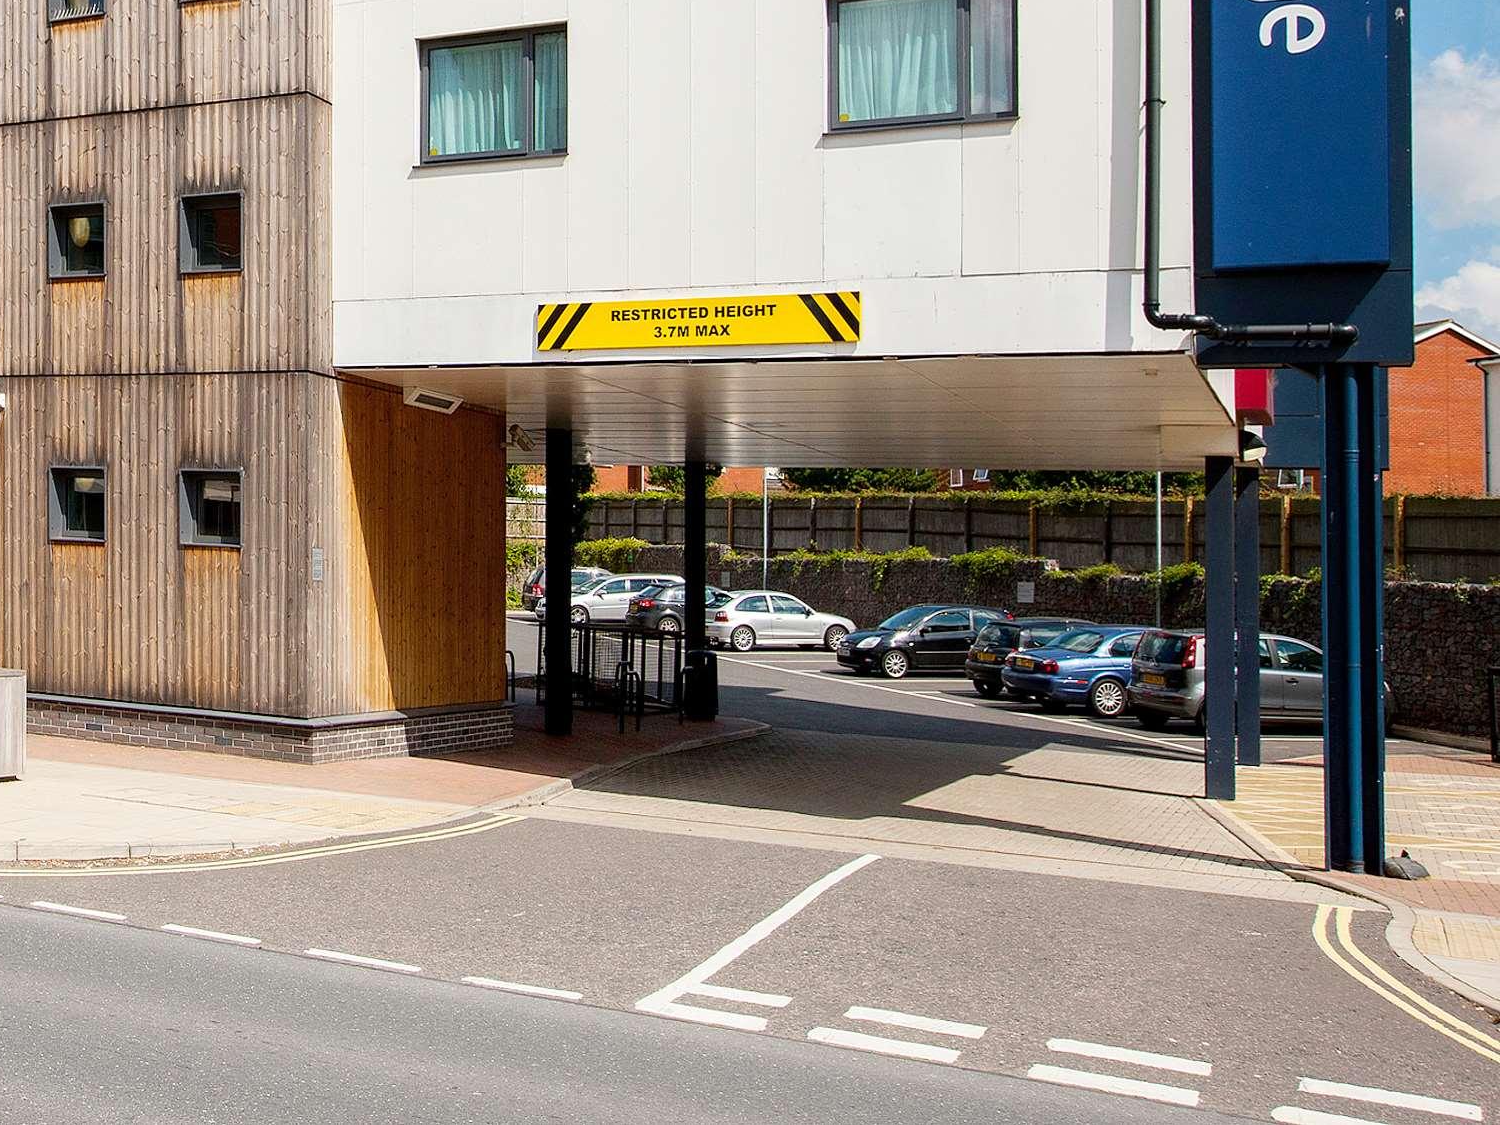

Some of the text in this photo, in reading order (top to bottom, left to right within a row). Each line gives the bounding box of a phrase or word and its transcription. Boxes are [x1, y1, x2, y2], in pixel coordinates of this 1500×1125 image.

[610, 304, 777, 322] RESTRICTED HEIGHT
[653, 323, 731, 339] 3.7M MAX
